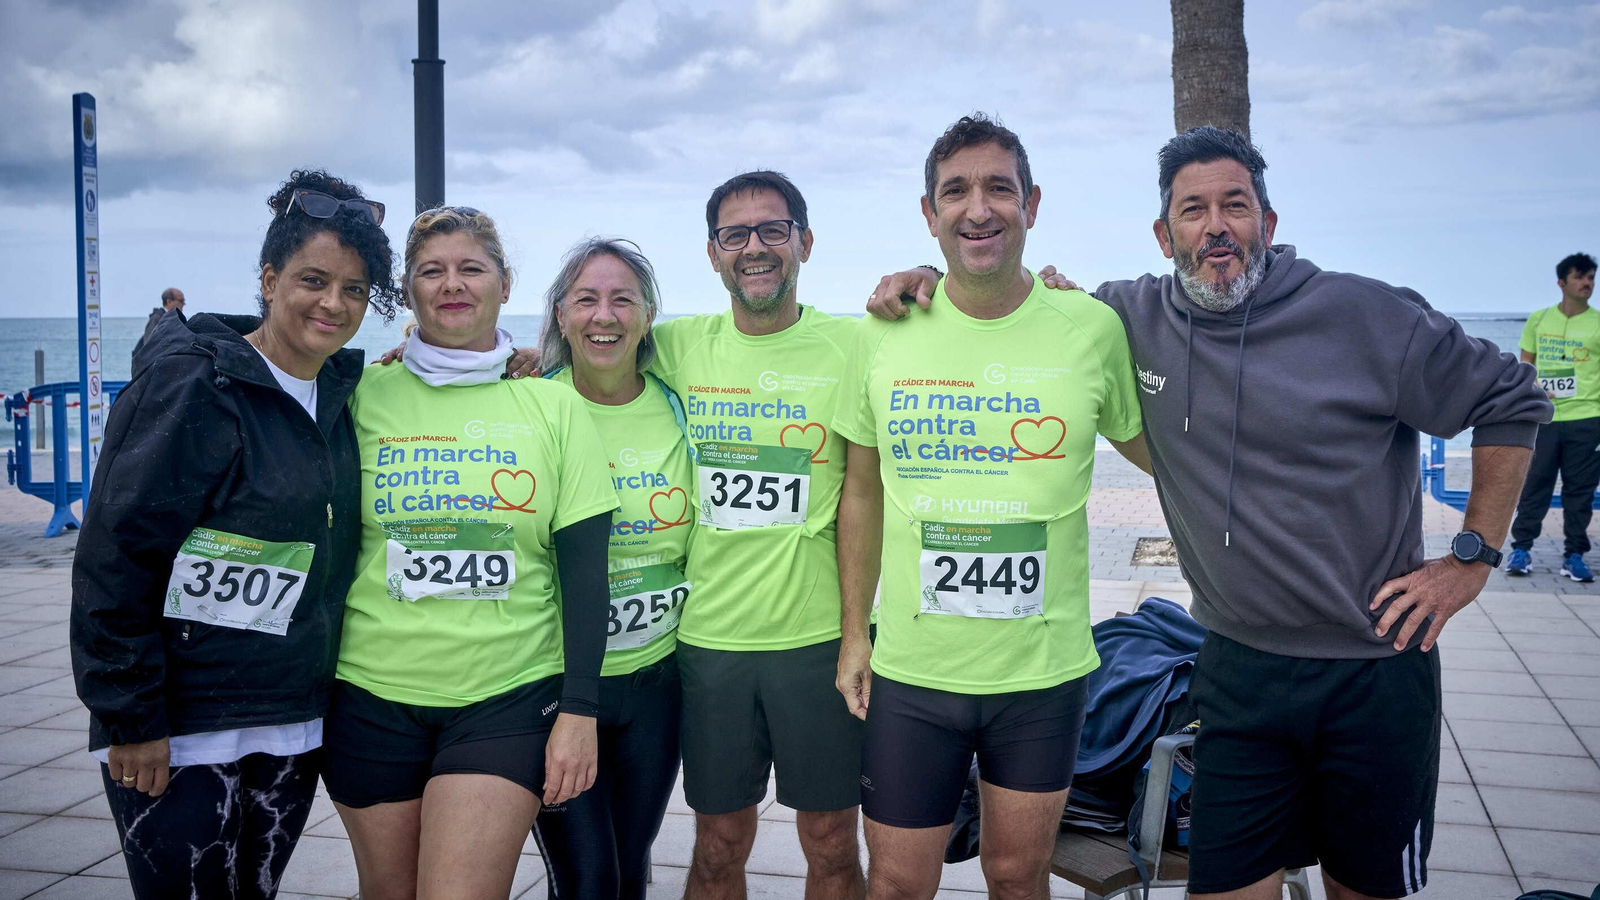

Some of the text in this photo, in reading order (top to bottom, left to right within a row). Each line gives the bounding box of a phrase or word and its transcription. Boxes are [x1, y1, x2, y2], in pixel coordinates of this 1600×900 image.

[1539, 346, 1564, 354] contra
[1550, 338, 1583, 347] marcha
[901, 378, 924, 386] CÁDIZ
[938, 380, 975, 388] MARCHA
[1542, 378, 1574, 391] 2162
[688, 395, 806, 420] En marcha
[890, 390, 1040, 413] En marcha
[690, 421, 752, 441] contra
[888, 414, 976, 436] contra
[377, 445, 517, 466] En marcha
[892, 439, 1019, 463] el cáncer
[375, 466, 460, 489] contra
[611, 471, 669, 490] rcha
[984, 468, 1009, 476] CÁNCER
[374, 489, 499, 514] el cáncer
[710, 472, 801, 512] 3251
[941, 498, 1028, 515] HYUNDAI
[924, 523, 944, 532] Cádiz
[959, 526, 991, 534] marcha
[962, 534, 992, 542] cáncer
[191, 539, 219, 550] contra
[220, 544, 229, 552] el
[217, 535, 228, 543] en
[229, 537, 263, 549] marcha
[404, 549, 509, 588] 3249
[614, 570, 642, 580] marcha
[934, 556, 1040, 595] 2449
[183, 561, 300, 610] 3507
[619, 577, 643, 587] cáncer
